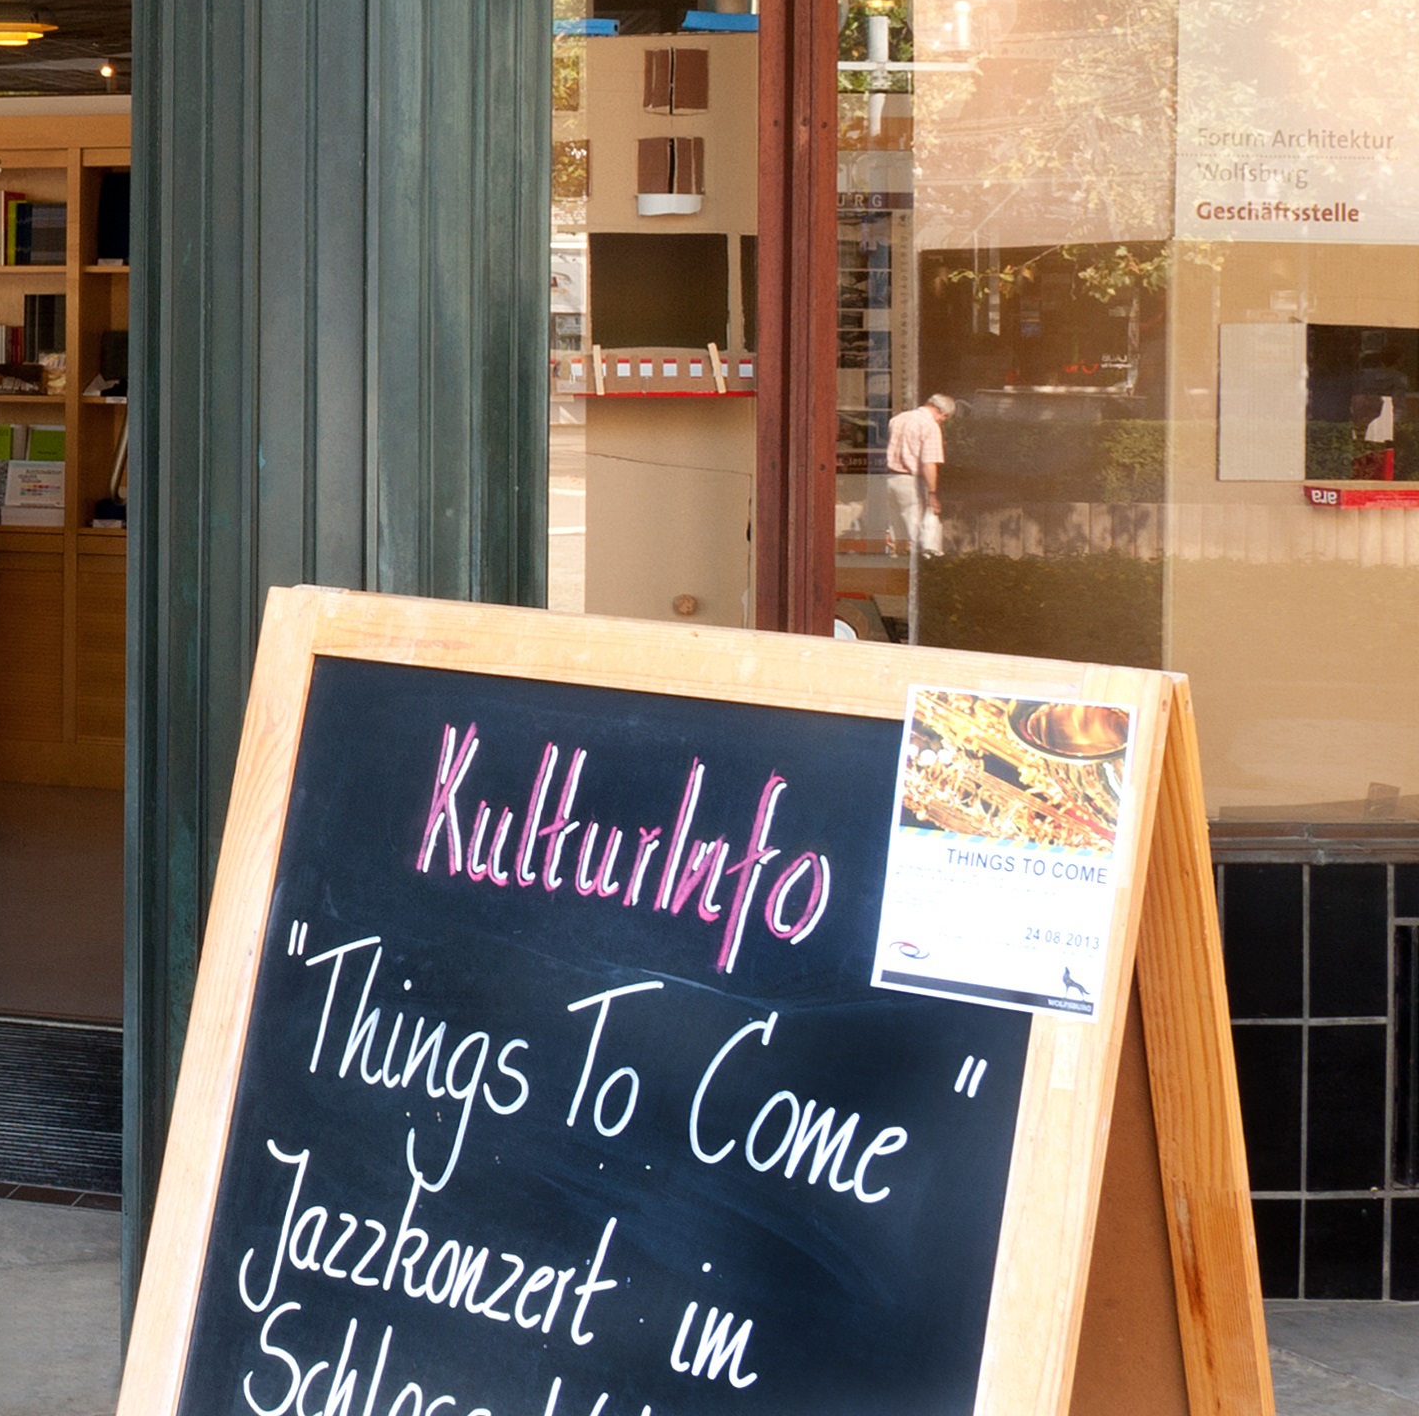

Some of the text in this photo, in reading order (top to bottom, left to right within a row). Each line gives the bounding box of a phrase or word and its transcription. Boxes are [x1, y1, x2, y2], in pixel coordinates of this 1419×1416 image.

[1197, 127, 1394, 150] Forum Architektur
[1196, 162, 1310, 190] Wolfsburg
[1196, 201, 1360, 222] Geschäftsstelle
[415, 721, 832, 975] KulturInfo
[946, 848, 1015, 873] THINGS
[1022, 858, 1046, 877] TO
[1051, 861, 1109, 885] COME
[567, 980, 665, 1138] To
[689, 1011, 909, 1204] Come
[239, 1138, 759, 1389] Jazzkonzert im
